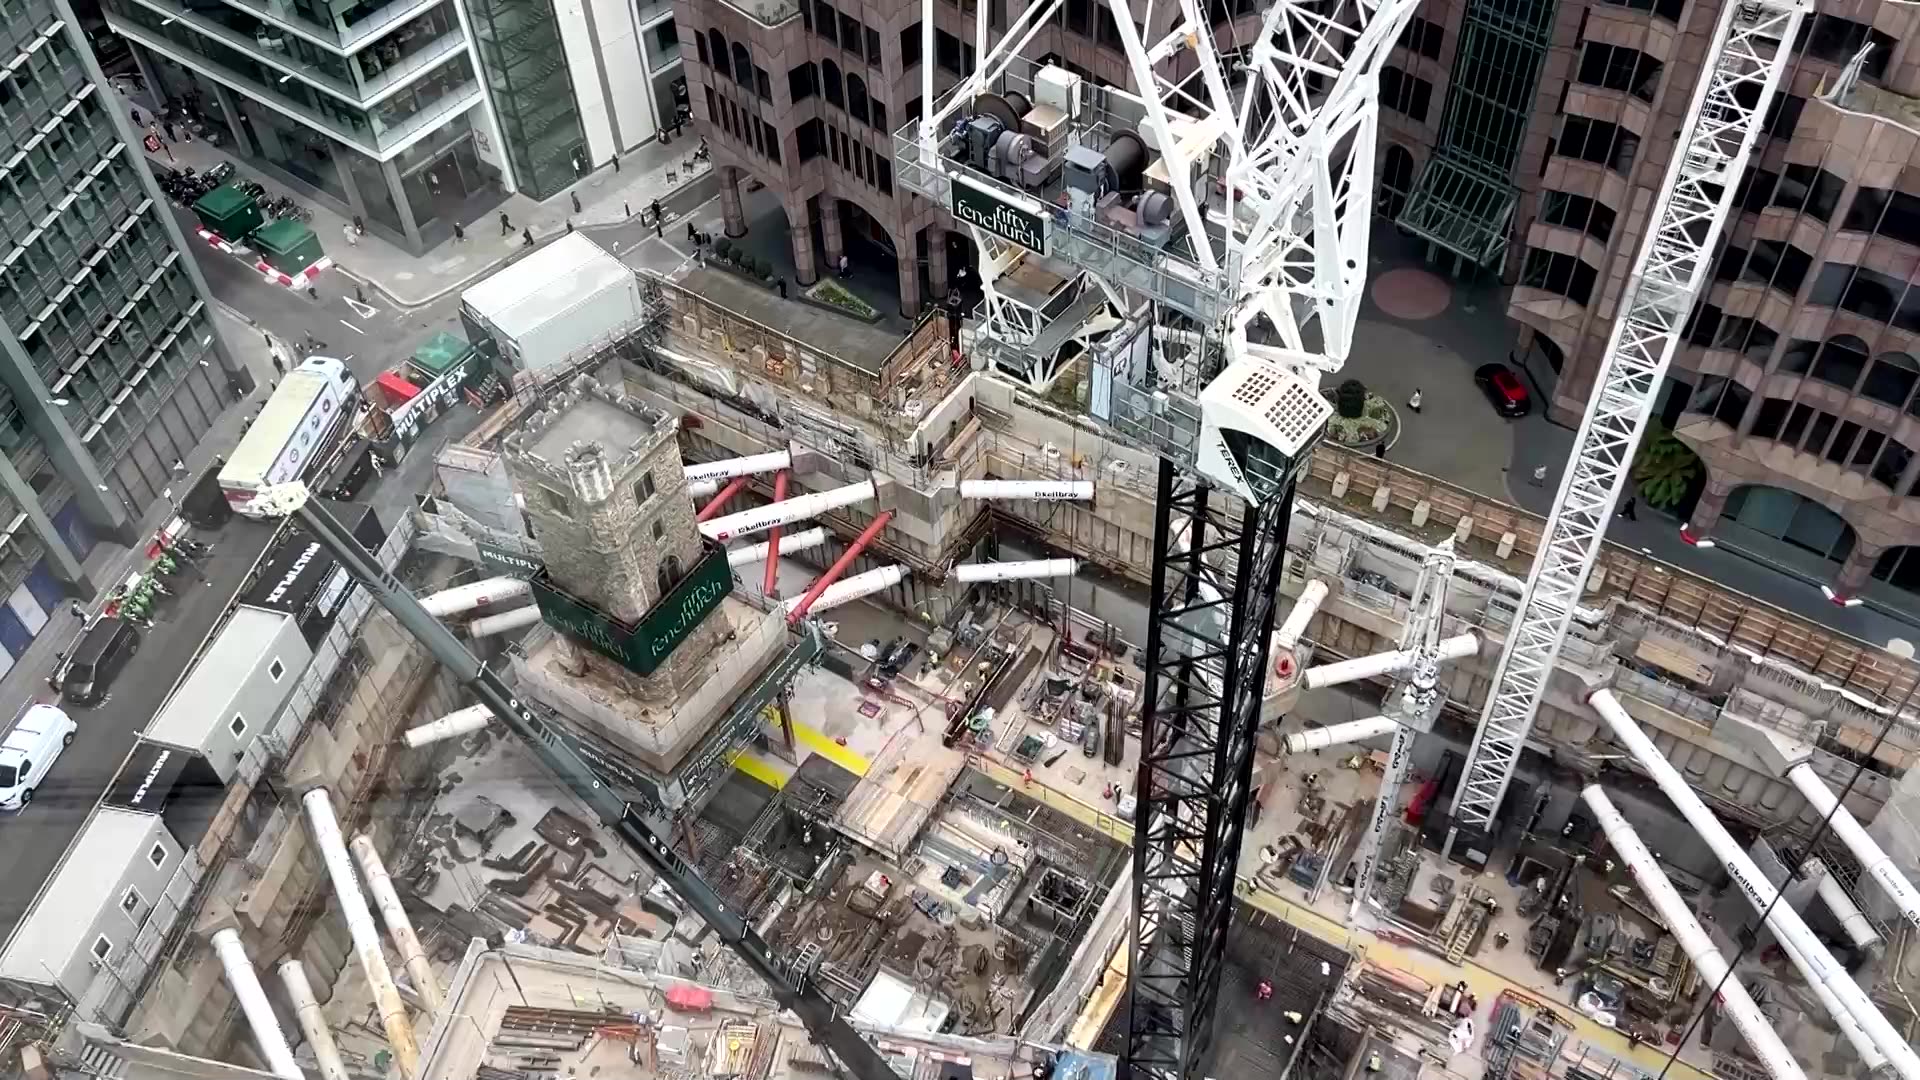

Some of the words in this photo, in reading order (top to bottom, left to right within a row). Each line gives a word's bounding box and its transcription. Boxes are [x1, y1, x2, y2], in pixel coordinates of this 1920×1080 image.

[958, 199, 1041, 250] fenchurch
[996, 204, 1029, 231] fifty
[396, 365, 467, 439] MULTIPLEX
[1216, 440, 1244, 483] TEREX
[265, 542, 320, 603] MULTIPLEX
[651, 580, 722, 657] fenchurch
[131, 750, 170, 803] MULTIPLEX
[1733, 868, 1767, 908] keltbray
